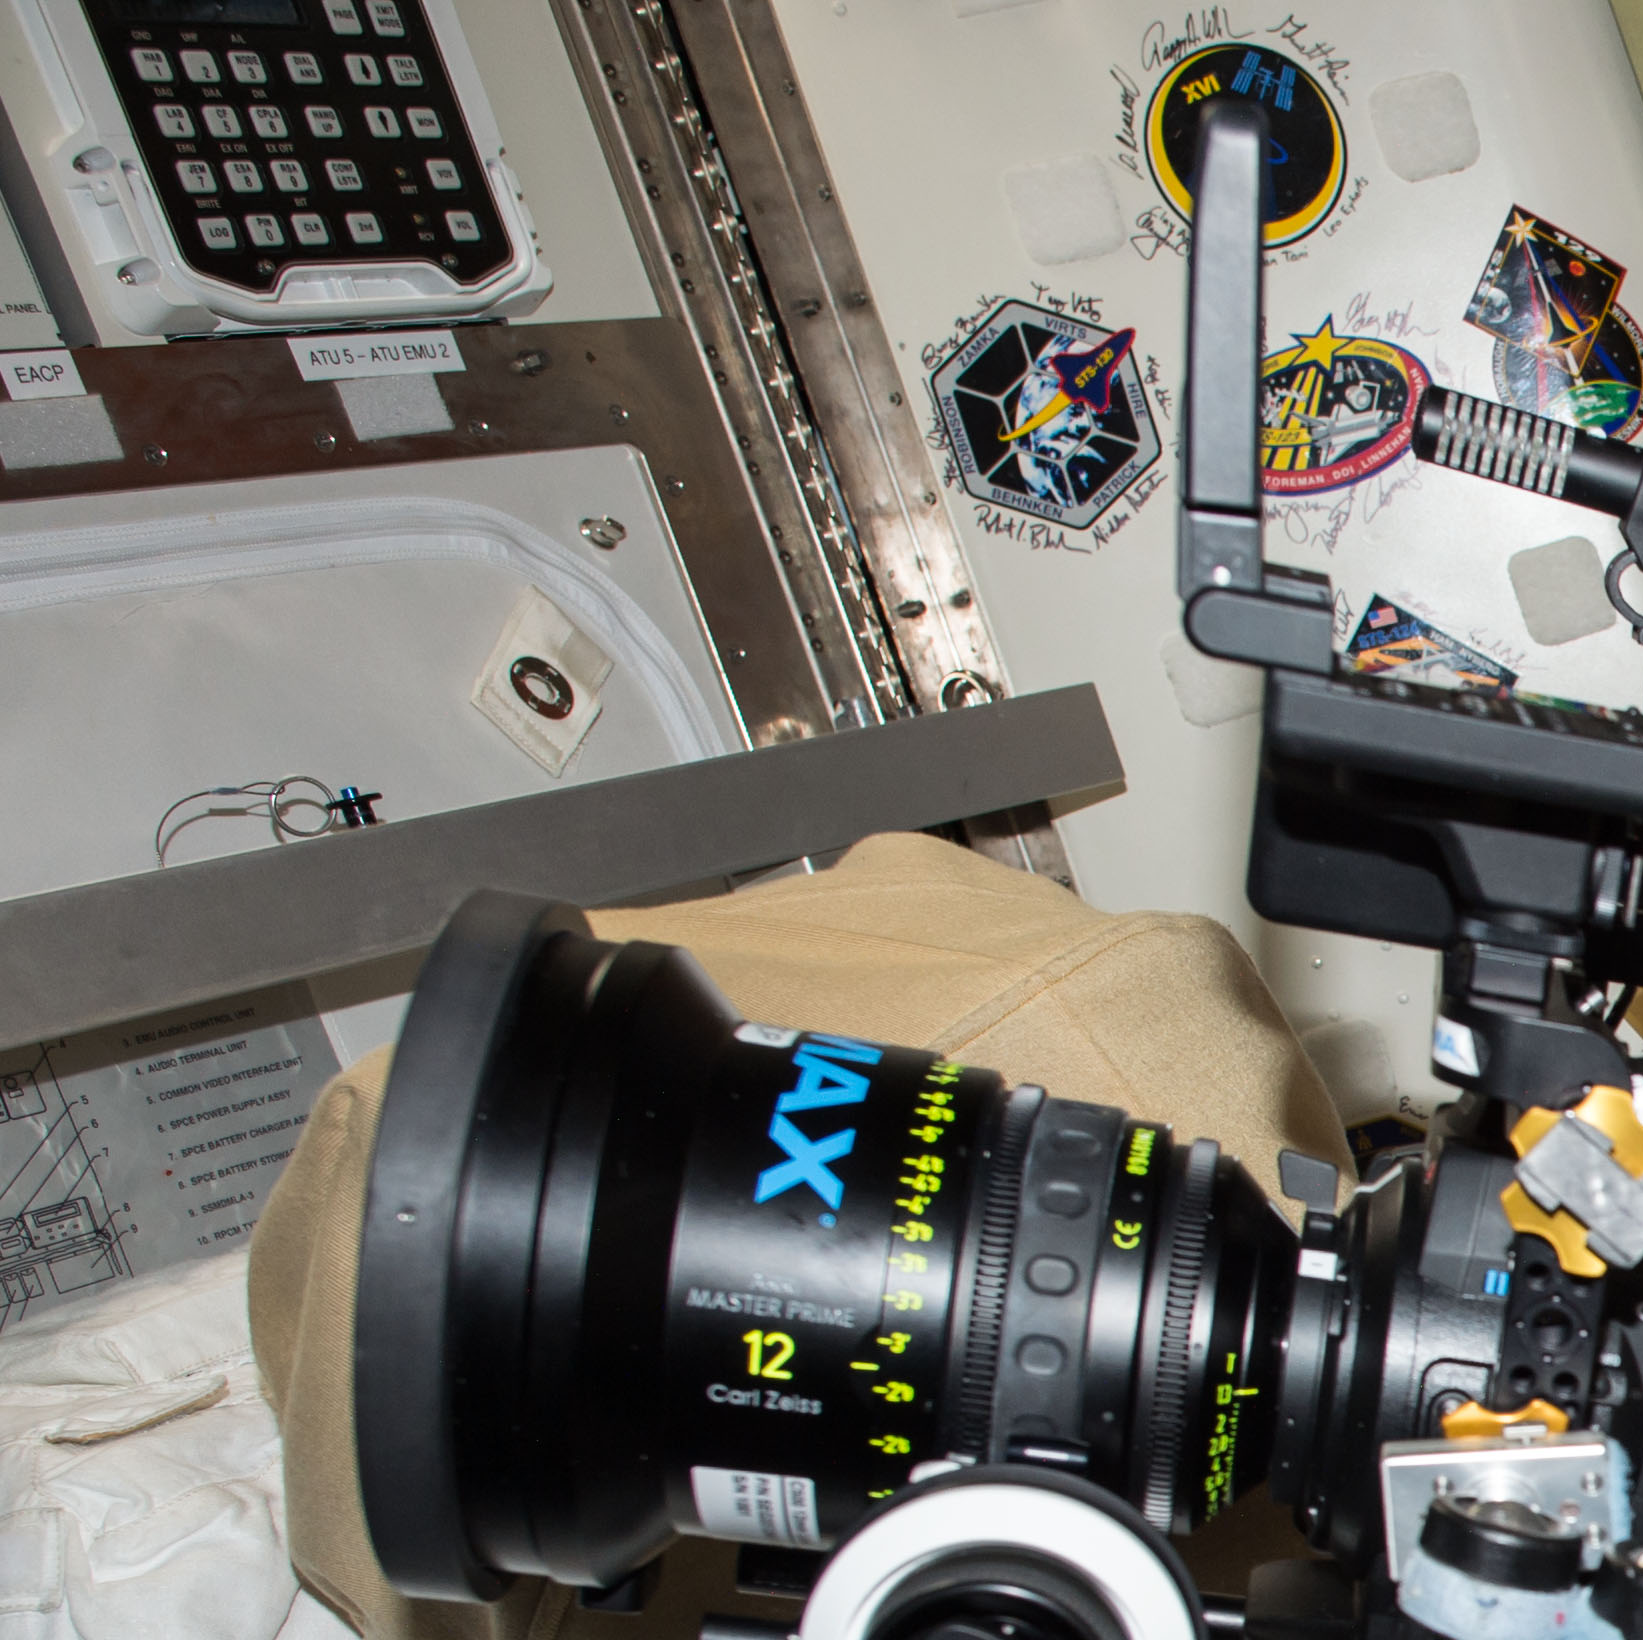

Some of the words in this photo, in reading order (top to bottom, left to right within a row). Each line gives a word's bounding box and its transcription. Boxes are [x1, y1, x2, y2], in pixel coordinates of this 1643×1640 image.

[202, 66, 211, 78] 2
[1181, 73, 1222, 104] XVI
[210, 228, 230, 238] LOG
[1043, 316, 1088, 340] VIRTS
[310, 349, 341, 367] ATU
[344, 347, 356, 364] 5
[370, 345, 402, 363] ATU
[403, 344, 437, 361] EMU
[438, 342, 450, 359] 2
[957, 326, 1001, 369] ZAMKA
[14, 365, 65, 385] EACP
[1126, 382, 1148, 419] HIRE
[941, 395, 977, 475] ROBINSON
[1360, 426, 1413, 470] LINNEHAN
[1091, 460, 1143, 508] PATRICK
[1264, 474, 1325, 488] FOREMAN
[1332, 467, 1356, 481] DOI
[990, 487, 1064, 519] BEHNKEN
[158, 1025, 189, 1041] AUDIO
[190, 1014, 235, 1034] CONTROL
[236, 1007, 257, 1023] UNIT
[147, 1057, 178, 1074] AUDIO
[178, 1046, 225, 1067] TERMINAL
[225, 1039, 249, 1055] UNIT
[159, 1084, 202, 1103] COMMON
[202, 1076, 231, 1092] VIDEO
[231, 1062, 282, 1085] INTERFACE
[282, 1055, 304, 1070] UNIT
[80, 1094, 89, 1105] 5
[169, 1114, 195, 1130] SPCE
[196, 1105, 225, 1122] POWER
[225, 1095, 266, 1115] SUPPLY
[267, 1089, 292, 1105] ASSY
[91, 1118, 99, 1129] 6
[208, 1130, 249, 1151] BATTERY
[249, 1119, 292, 1140] CHARGER
[103, 1147, 110, 1158] 7
[217, 1158, 259, 1179] BATTERY
[123, 1202, 131, 1213] 8
[131, 1223, 139, 1234] 9
[213, 1226, 241, 1242] RPCM
[686, 1287, 782, 1319] MASTER
[785, 1300, 856, 1329] PRIME
[741, 1328, 796, 1381] 12
[705, 1383, 761, 1409] Carl
[763, 1389, 823, 1416] Zeiss
